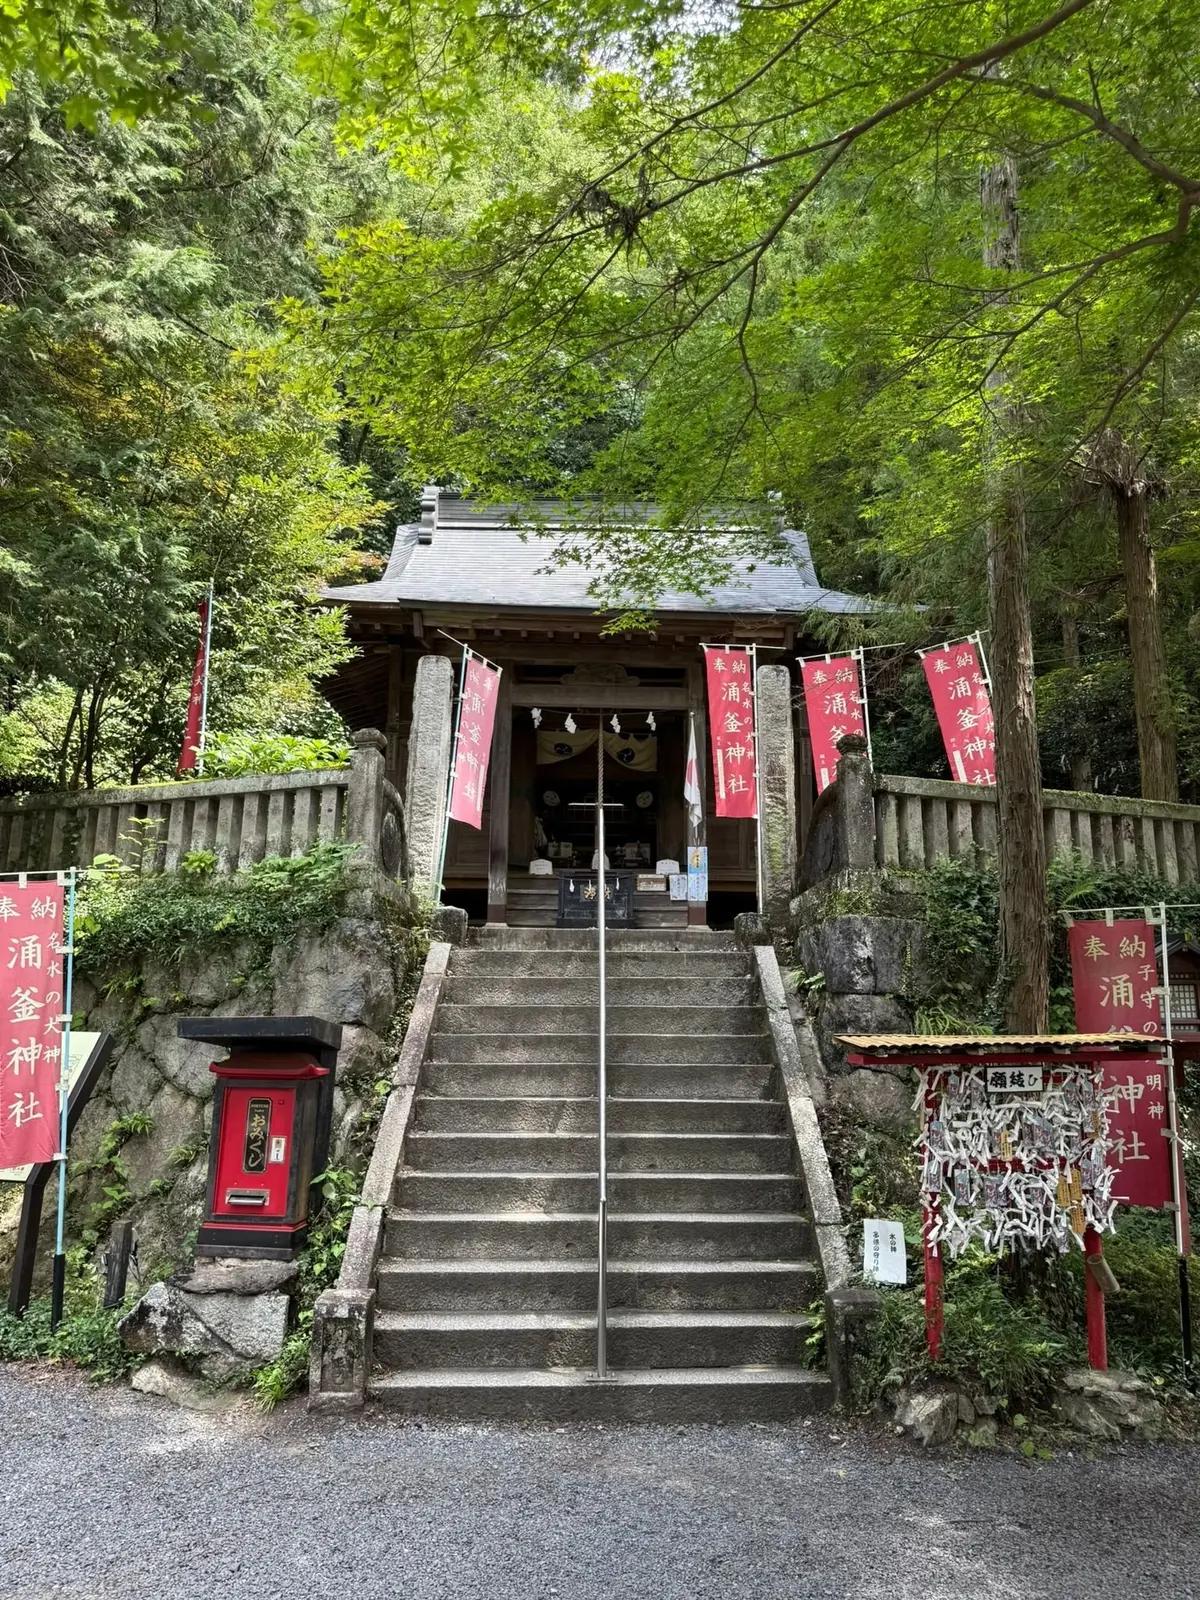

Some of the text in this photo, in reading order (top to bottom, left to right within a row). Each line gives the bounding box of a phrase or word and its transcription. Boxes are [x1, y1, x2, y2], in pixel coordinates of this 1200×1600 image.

[713, 657, 747, 674] 奉納
[813, 667, 853, 686] 奉納
[934, 652, 973, 674] 奉納
[721, 681, 750, 794] 涌釜神社
[947, 676, 997, 786] 涌釜神社
[0, 895, 57, 923] 奉納
[1083, 934, 1147, 962] 奉納
[2, 934, 46, 1128] 涌釜神社
[1137, 963, 1165, 1121] 子守の明神
[990, 1070, 1039, 1089] 願結び
[1099, 973, 1151, 1165] 涌神社
[248, 1113, 266, 1168] おみくじ
